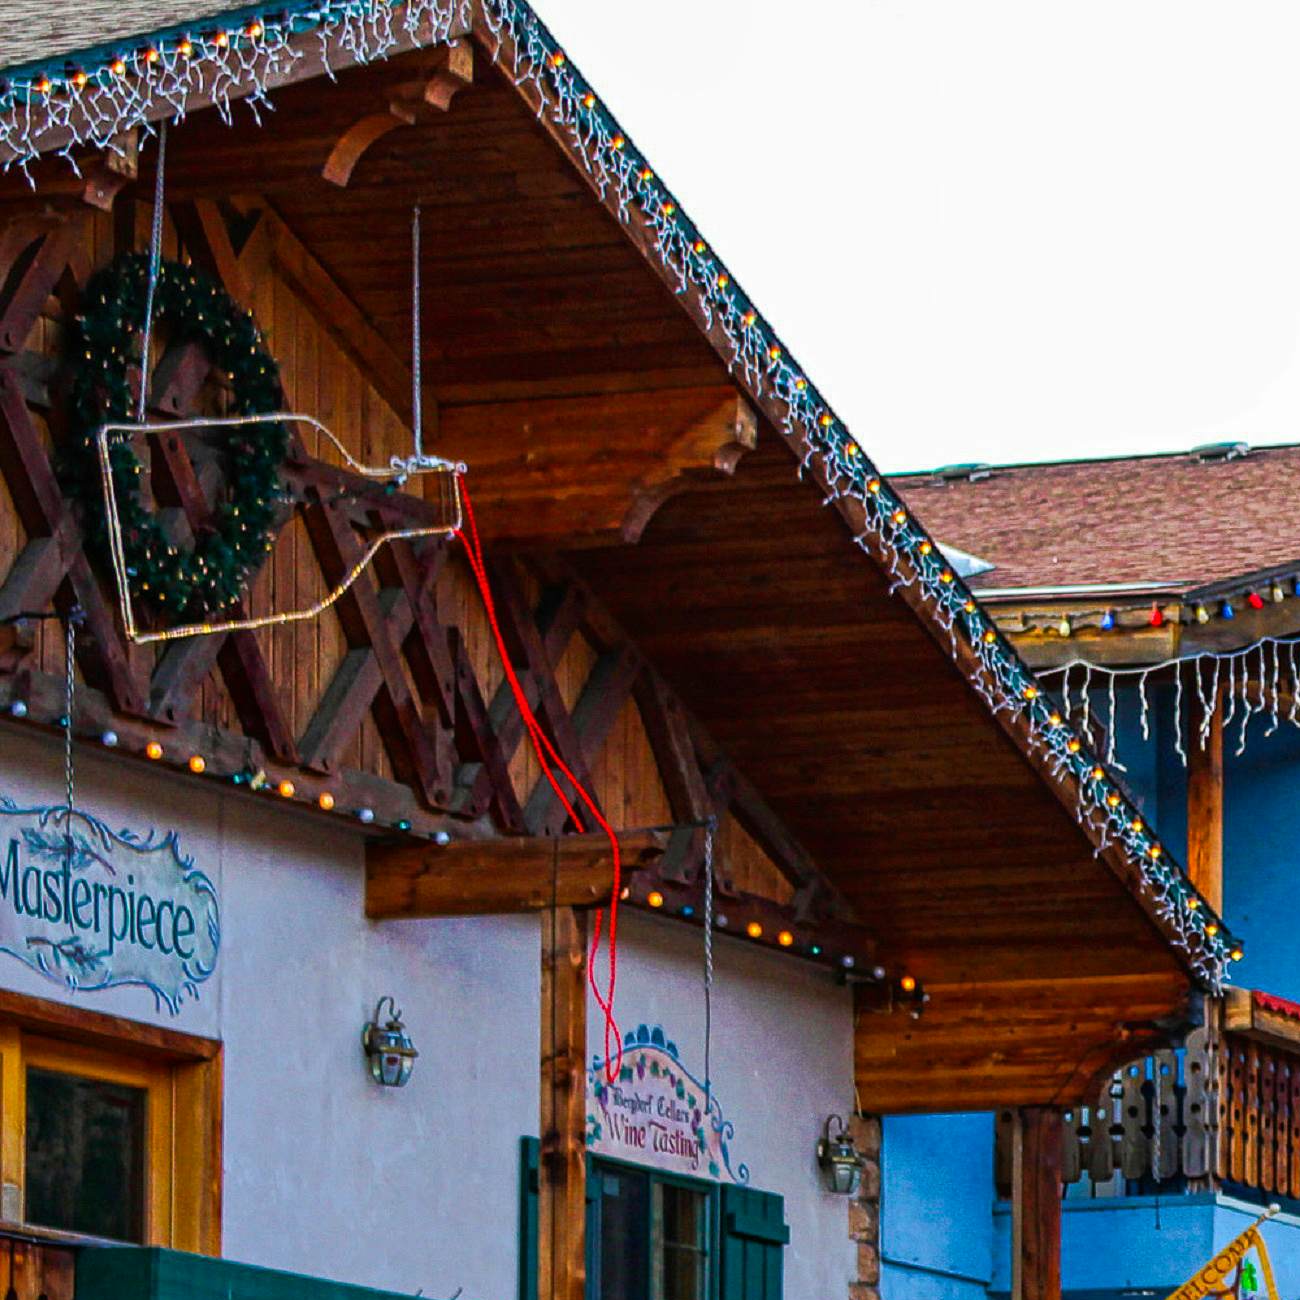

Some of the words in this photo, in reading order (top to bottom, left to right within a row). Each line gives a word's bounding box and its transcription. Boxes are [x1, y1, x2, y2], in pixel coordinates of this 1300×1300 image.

[0, 838, 195, 960] Masterpiece
[600, 1110, 646, 1148] Wine
[649, 1120, 699, 1170] Tasting
